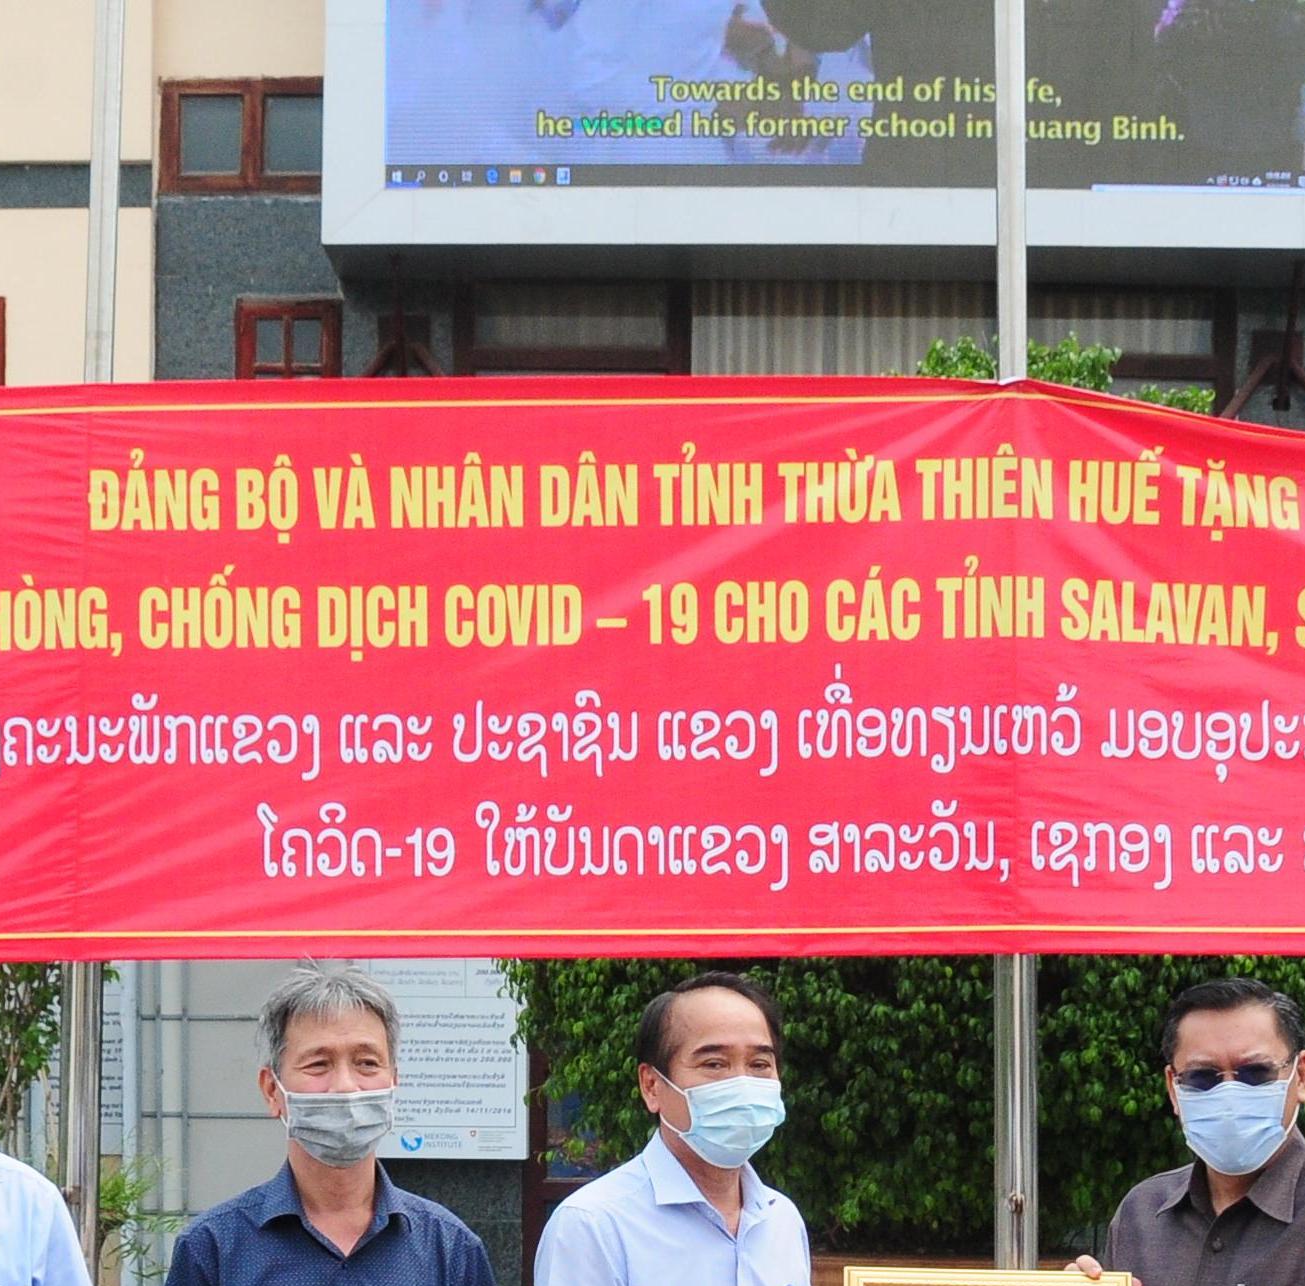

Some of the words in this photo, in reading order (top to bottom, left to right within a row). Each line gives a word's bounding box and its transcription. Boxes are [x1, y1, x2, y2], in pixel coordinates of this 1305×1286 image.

[650, 75, 781, 101] Towards
[791, 75, 839, 101] the
[848, 76, 904, 102] end
[913, 77, 945, 102] of
[954, 78, 996, 102] his
[1026, 78, 1062, 107] fe,
[537, 111, 573, 137] he
[581, 111, 683, 138] visited
[692, 111, 736, 137] his
[746, 111, 849, 137] former
[858, 112, 955, 138] school
[966, 114, 993, 138] in
[1025, 118, 1101, 145] uang
[1111, 115, 1185, 141] Binh.
[87, 447, 220, 531] ĐẢNG
[236, 454, 299, 544] BỘ
[312, 453, 376, 530] VÀ
[390, 451, 524, 529] NHÂN
[539, 450, 639, 527] DÂN
[653, 441, 763, 526] TỈNH
[778, 447, 902, 524] THỪA
[915, 443, 1054, 521] THIÊN
[1068, 446, 1164, 525] HUẾ
[1175, 459, 1301, 542] TẶNG
[139, 564, 302, 650] CHỐNG
[317, 585, 428, 662] DỊCH
[444, 583, 583, 648] COVID
[642, 582, 699, 645] 19
[714, 579, 809, 644] CHO
[825, 565, 921, 642] CÁC
[935, 554, 1045, 640] TỈNH
[1060, 577, 1279, 655] SALAVAN,
